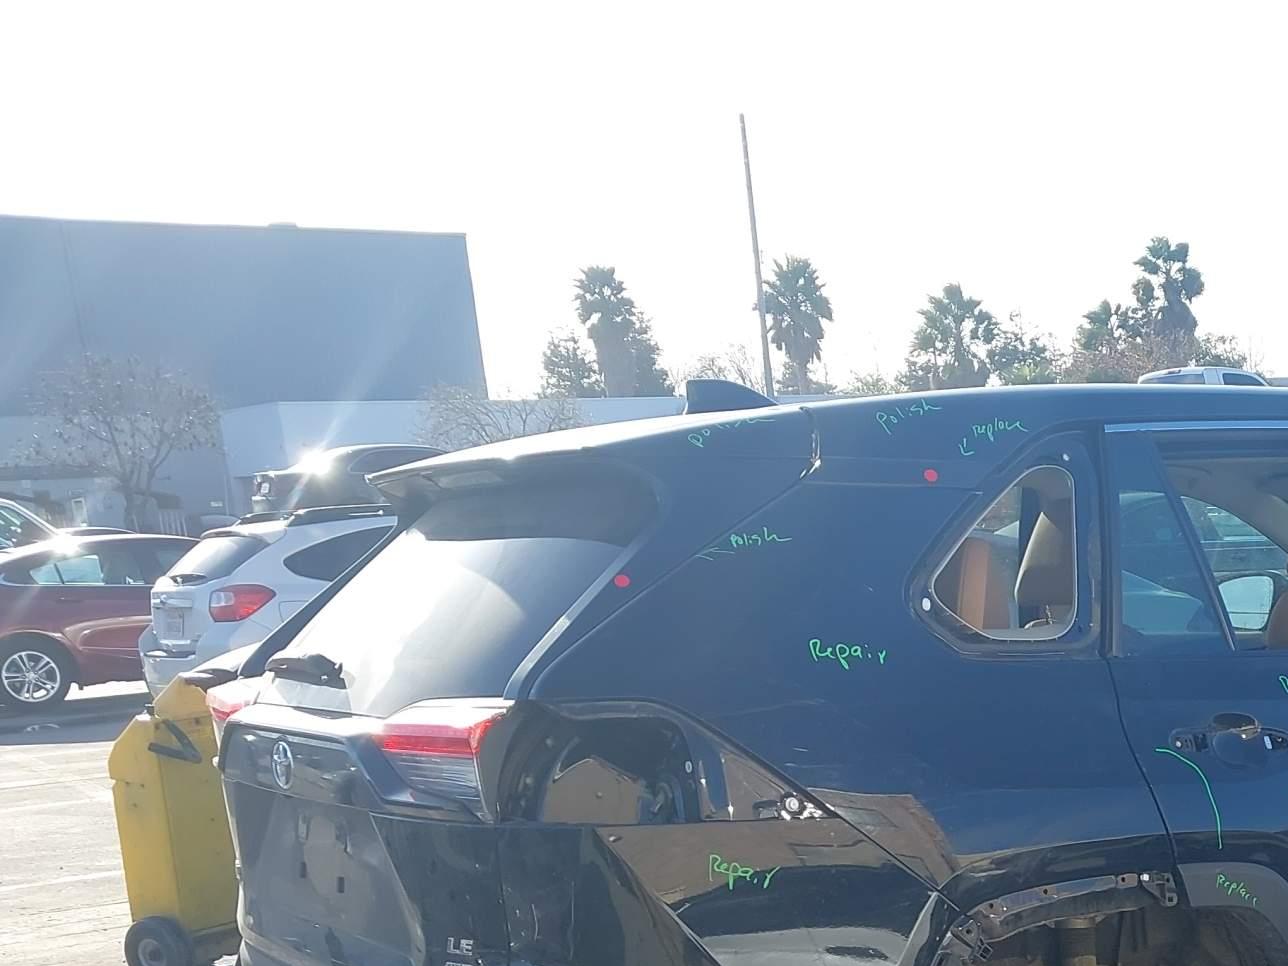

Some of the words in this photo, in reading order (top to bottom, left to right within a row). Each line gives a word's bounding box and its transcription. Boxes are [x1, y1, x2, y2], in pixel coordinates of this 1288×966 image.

[809, 638, 887, 670] Repair
[708, 854, 781, 890] Repair
[446, 937, 474, 956] LE
